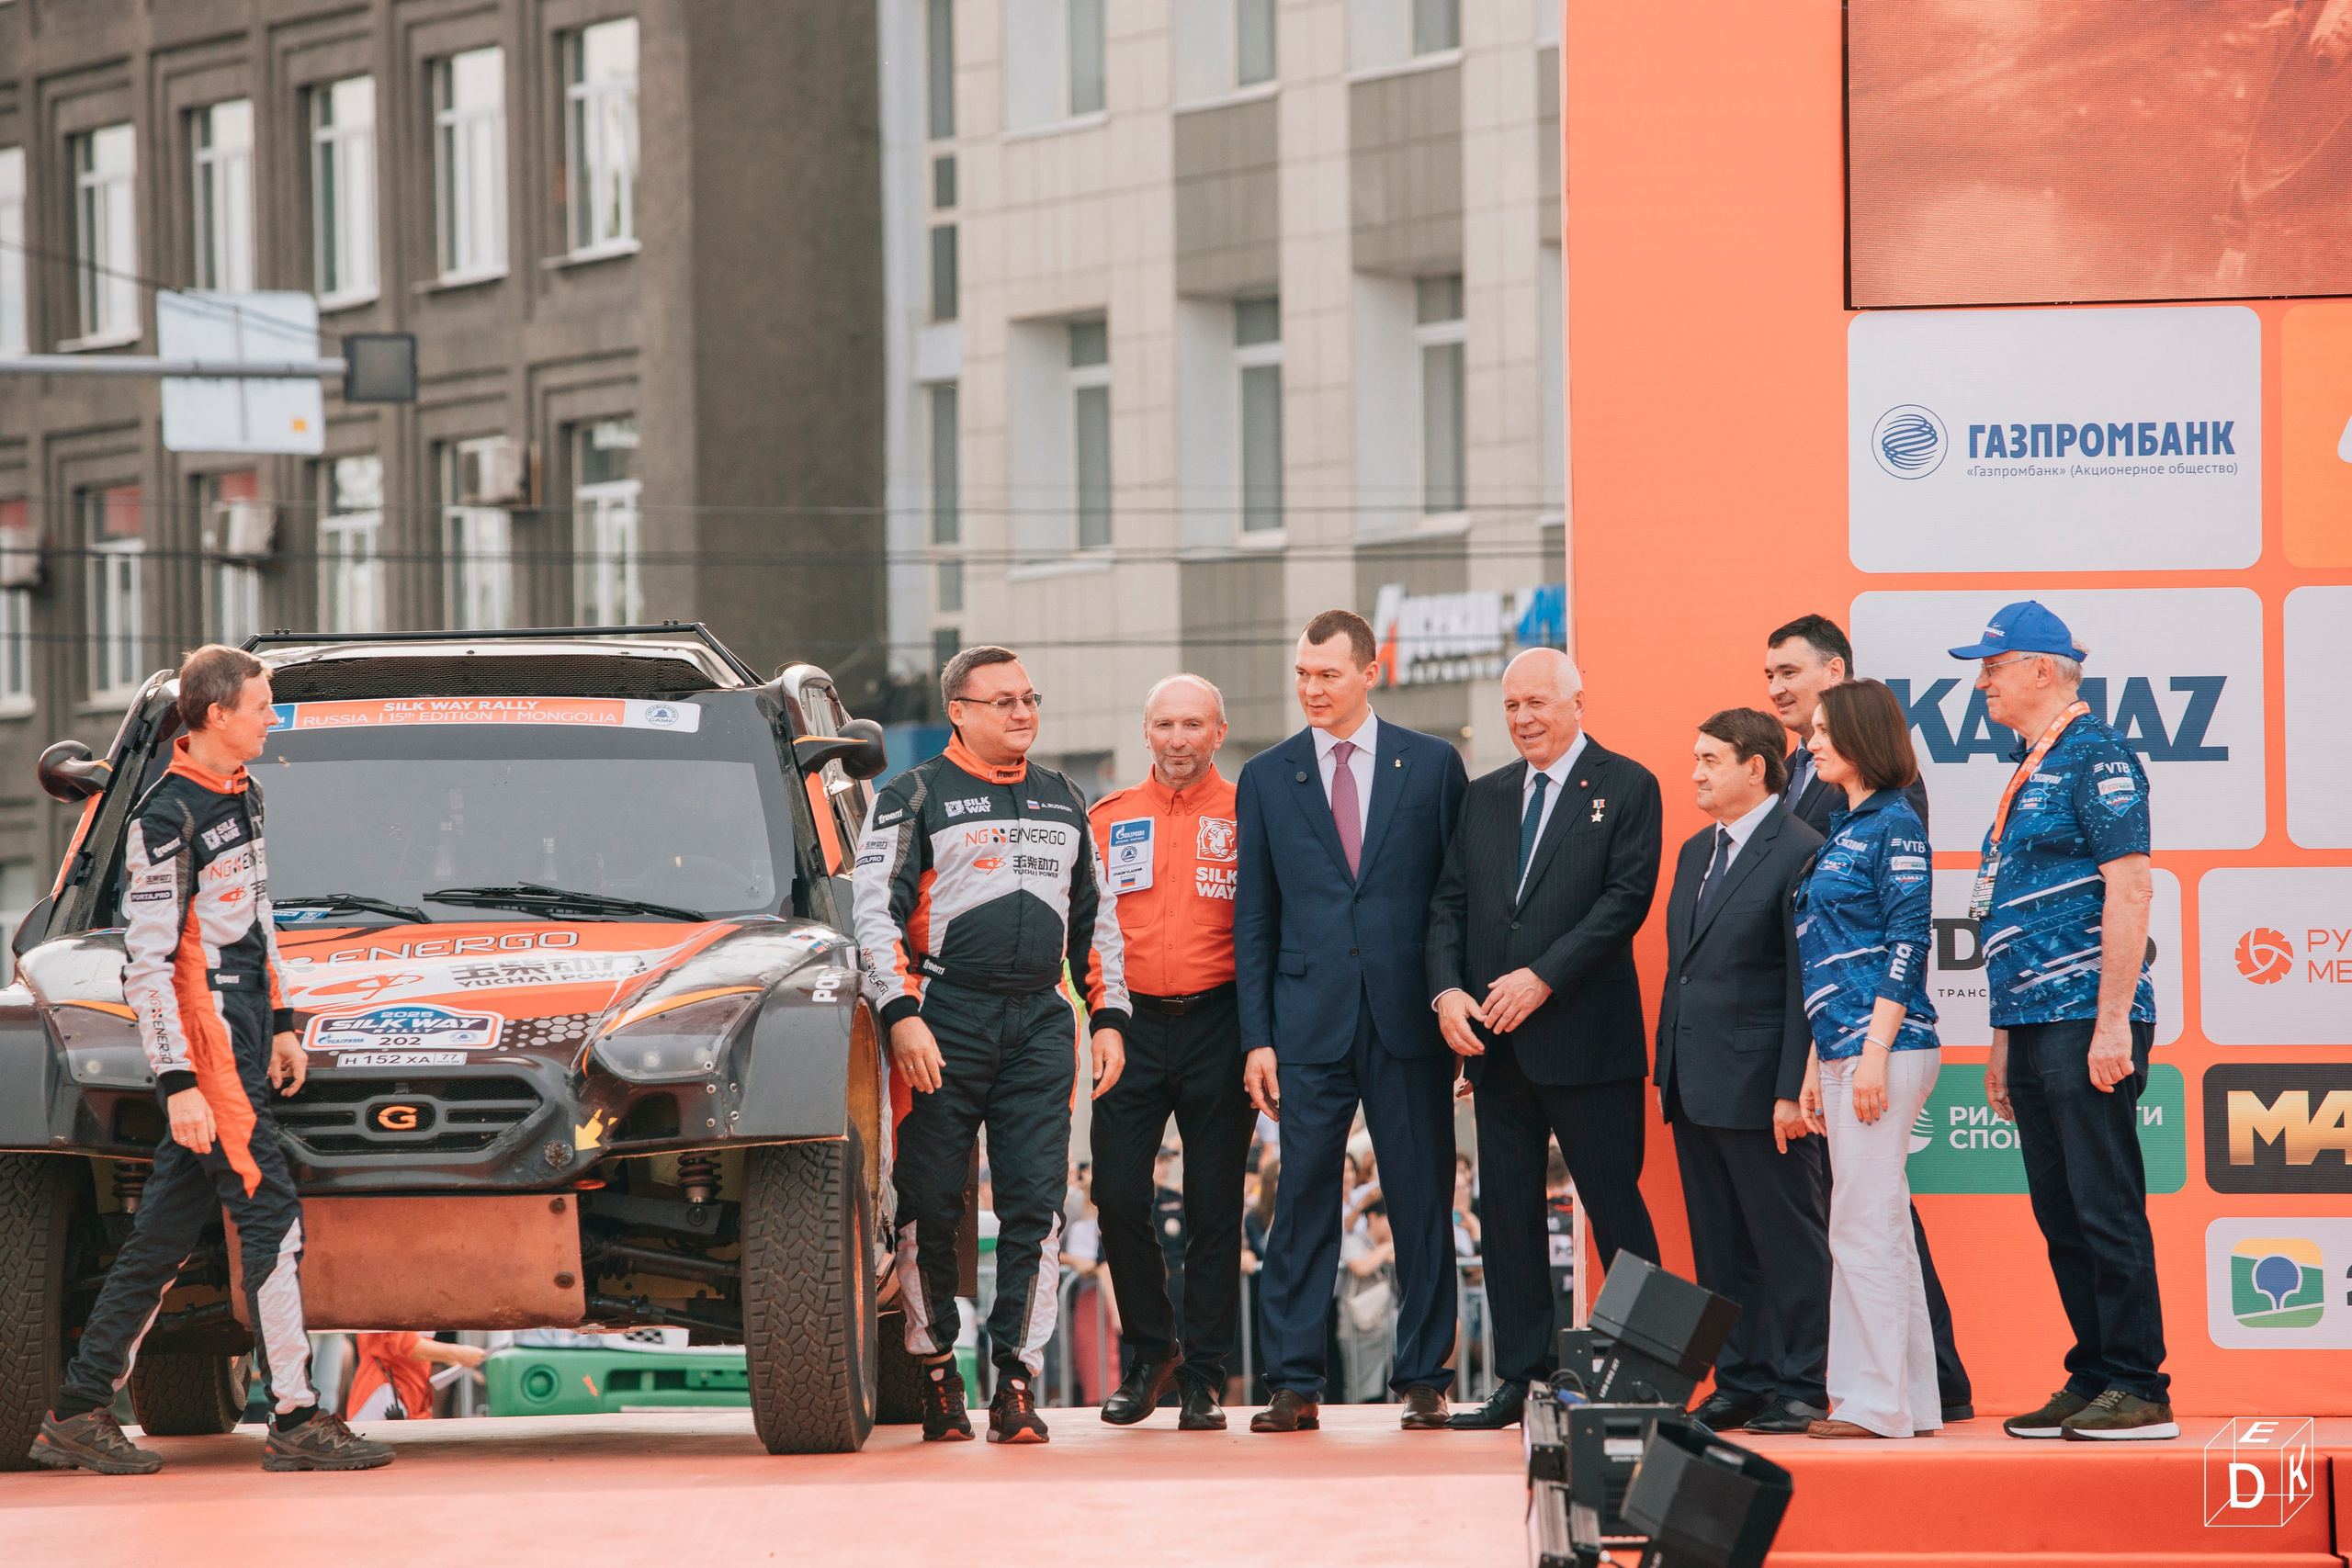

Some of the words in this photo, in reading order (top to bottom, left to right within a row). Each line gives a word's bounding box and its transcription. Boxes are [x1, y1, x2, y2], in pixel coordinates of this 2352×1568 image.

[1969, 422, 2236, 459] ГАЗПРОМБАНК
[1967, 465, 2066, 479] «Газпромбанк»
[2070, 463, 2165, 478] (Акционерное
[2169, 462, 2238, 477] общество)
[383, 702, 426, 712] SILK
[431, 701, 475, 711] WAY
[478, 700, 539, 711] RALLY
[303, 714, 369, 726] RUSSIA
[388, 712, 415, 723] 15th
[419, 711, 493, 722] EDITION
[517, 711, 617, 724] MONGOLIA
[997, 770, 1021, 779] freem
[2104, 761, 2132, 773] VTB
[963, 796, 991, 807] SILK
[965, 804, 991, 815] WAY
[878, 808, 904, 825] freem
[966, 829, 989, 847] NG
[1902, 840, 1927, 853] VTB
[153, 836, 182, 858] freem
[209, 859, 232, 881] NG
[1039, 870, 1059, 879] POWER
[1195, 867, 1238, 885] SILK
[1195, 882, 1237, 899] WAY
[327, 931, 579, 968] ENERGO
[2307, 929, 2352, 953] РУ
[922, 958, 946, 976] freem
[1889, 942, 1914, 982] ma
[459, 975, 552, 988] YUCHAI
[560, 967, 649, 981] POWER
[2308, 959, 2352, 984] МЕ
[148, 989, 162, 1006] NG
[1939, 988, 1987, 998] ТРАНС
[328, 1019, 406, 1031] SILK
[412, 1018, 483, 1030] WAY
[153, 1020, 174, 1065] ENERGO
[379, 1037, 422, 1046] 202
[364, 1055, 401, 1065] 152
[378, 1105, 418, 1131] G
[2226, 1089, 2352, 1166] МА
[1950, 1129, 2021, 1149] СПО
